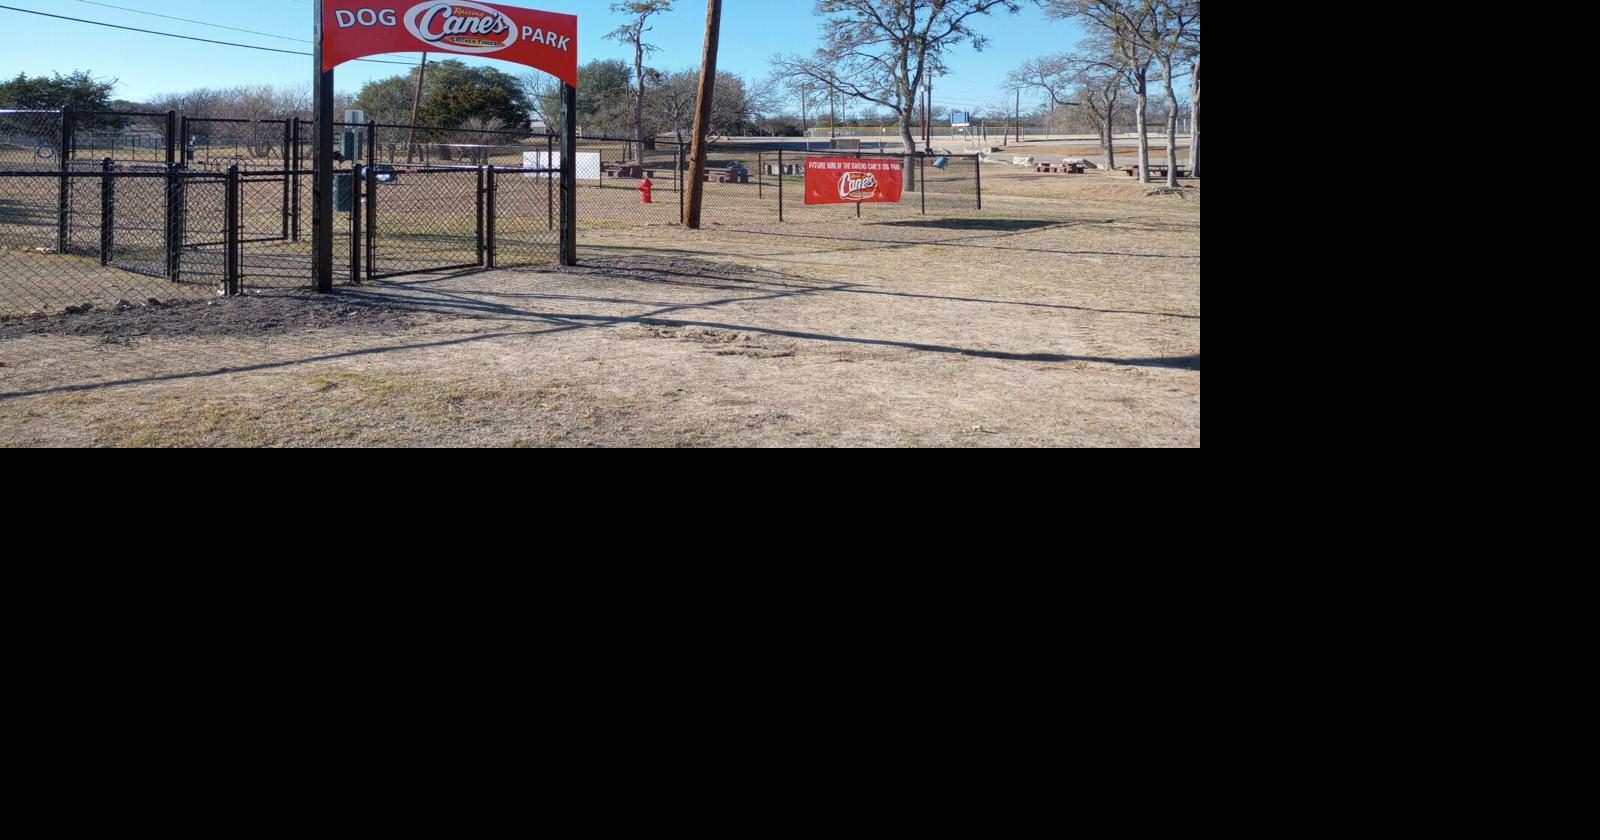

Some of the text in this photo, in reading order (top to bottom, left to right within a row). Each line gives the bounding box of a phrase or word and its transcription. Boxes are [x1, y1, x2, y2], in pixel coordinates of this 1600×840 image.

[335, 8, 571, 51] DOG PARK
[419, 3, 509, 42] Cane's
[453, 7, 485, 17] Raising
